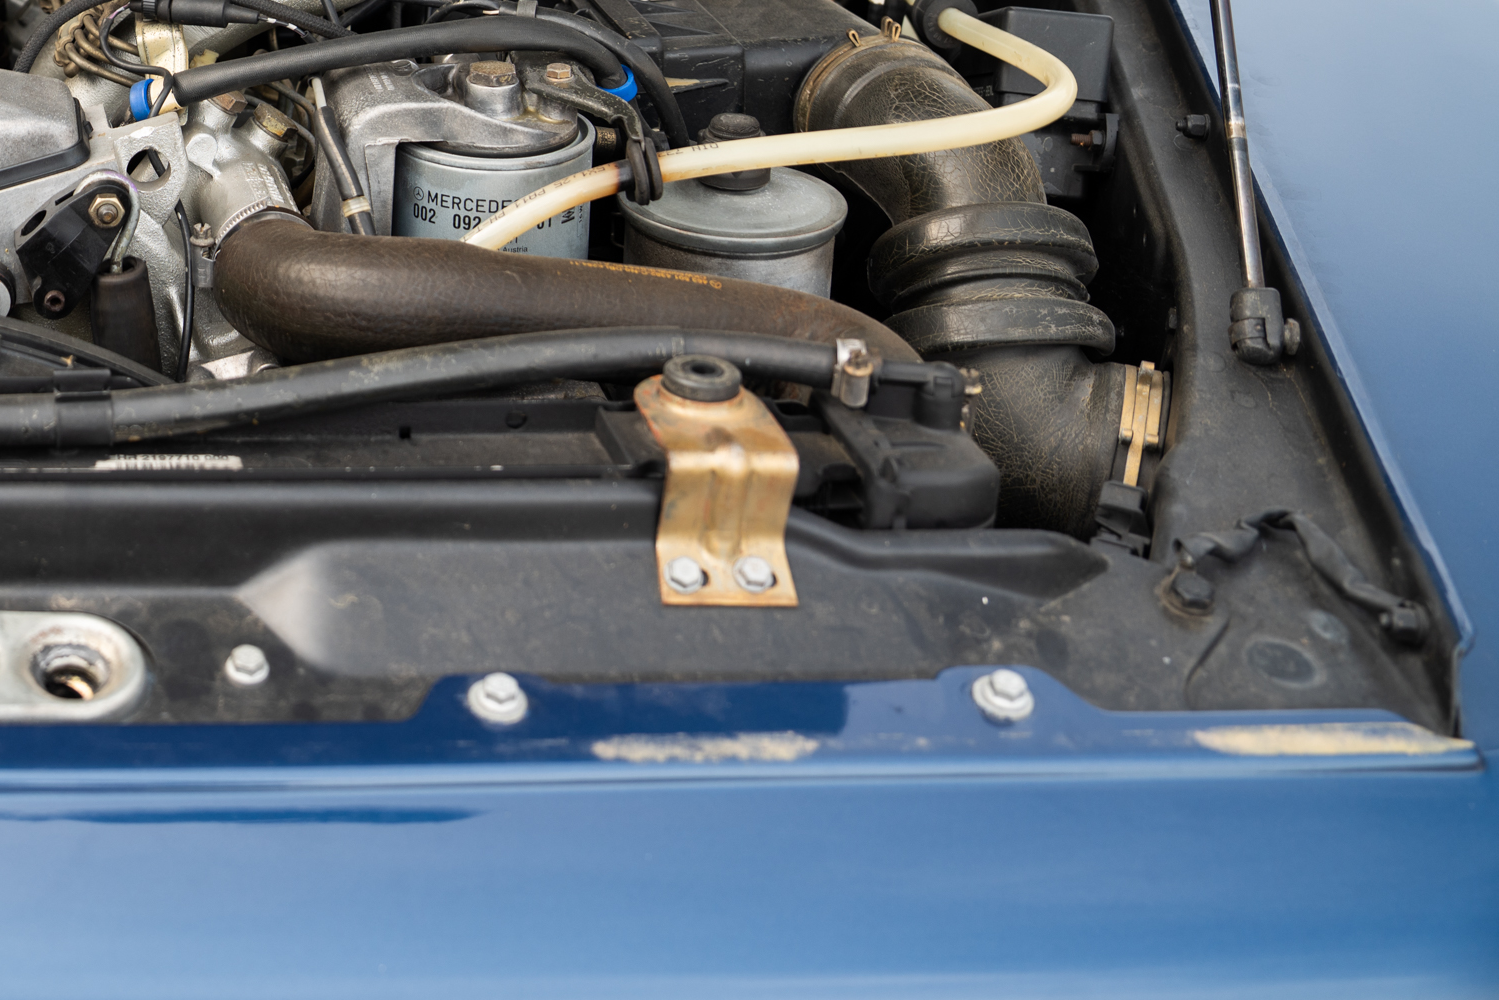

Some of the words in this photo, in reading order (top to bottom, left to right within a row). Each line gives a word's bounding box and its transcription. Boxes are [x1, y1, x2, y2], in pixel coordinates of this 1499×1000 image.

[691, 142, 719, 153] DIN
[427, 190, 519, 214] MERCEDE
[413, 203, 436, 224] 002
[453, 213, 482, 230] 092
